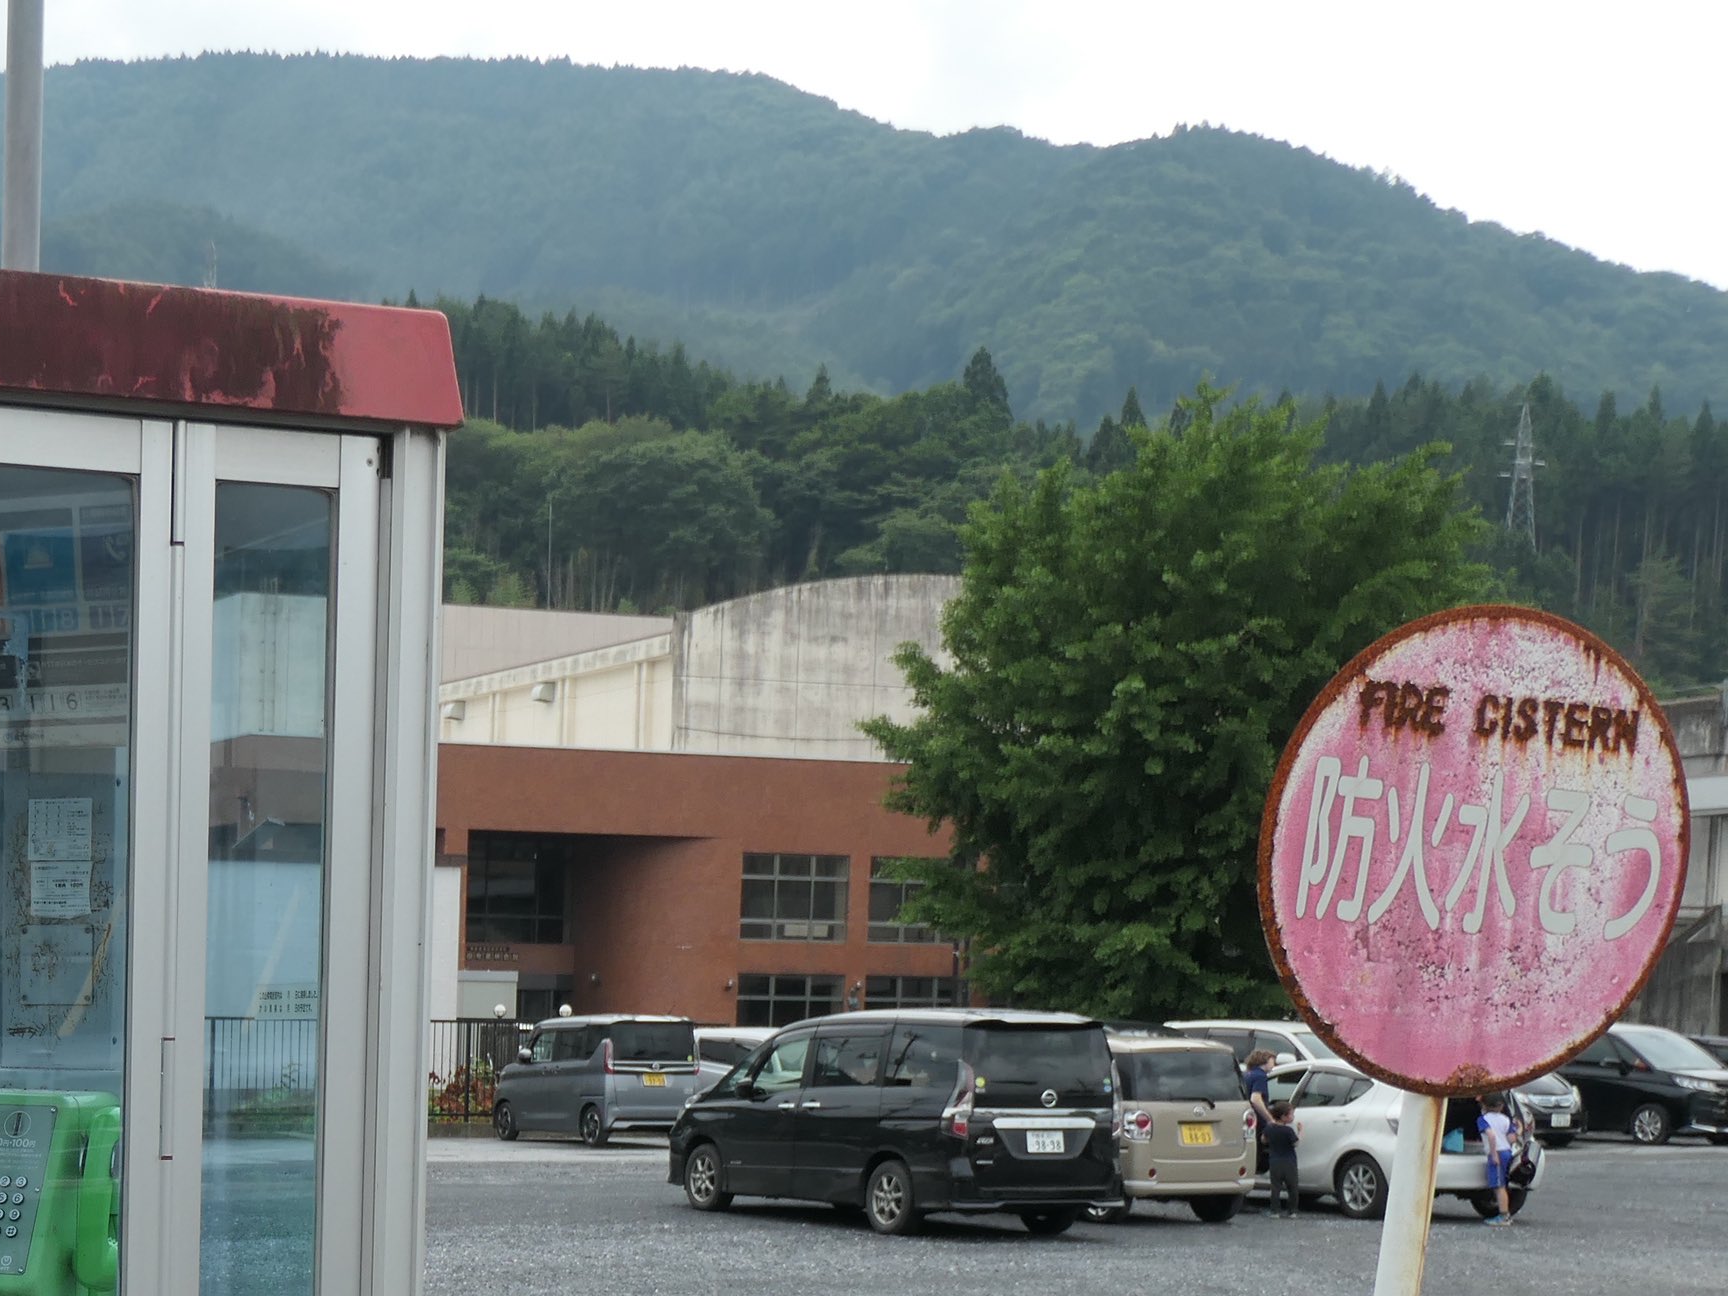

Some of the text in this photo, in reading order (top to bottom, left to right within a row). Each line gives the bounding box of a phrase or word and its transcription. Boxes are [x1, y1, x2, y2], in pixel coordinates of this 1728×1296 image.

[29, 692, 79, 711] 116
[1359, 680, 1641, 753] FIRE CISTERN
[1295, 754, 1662, 942] 防火水そう
